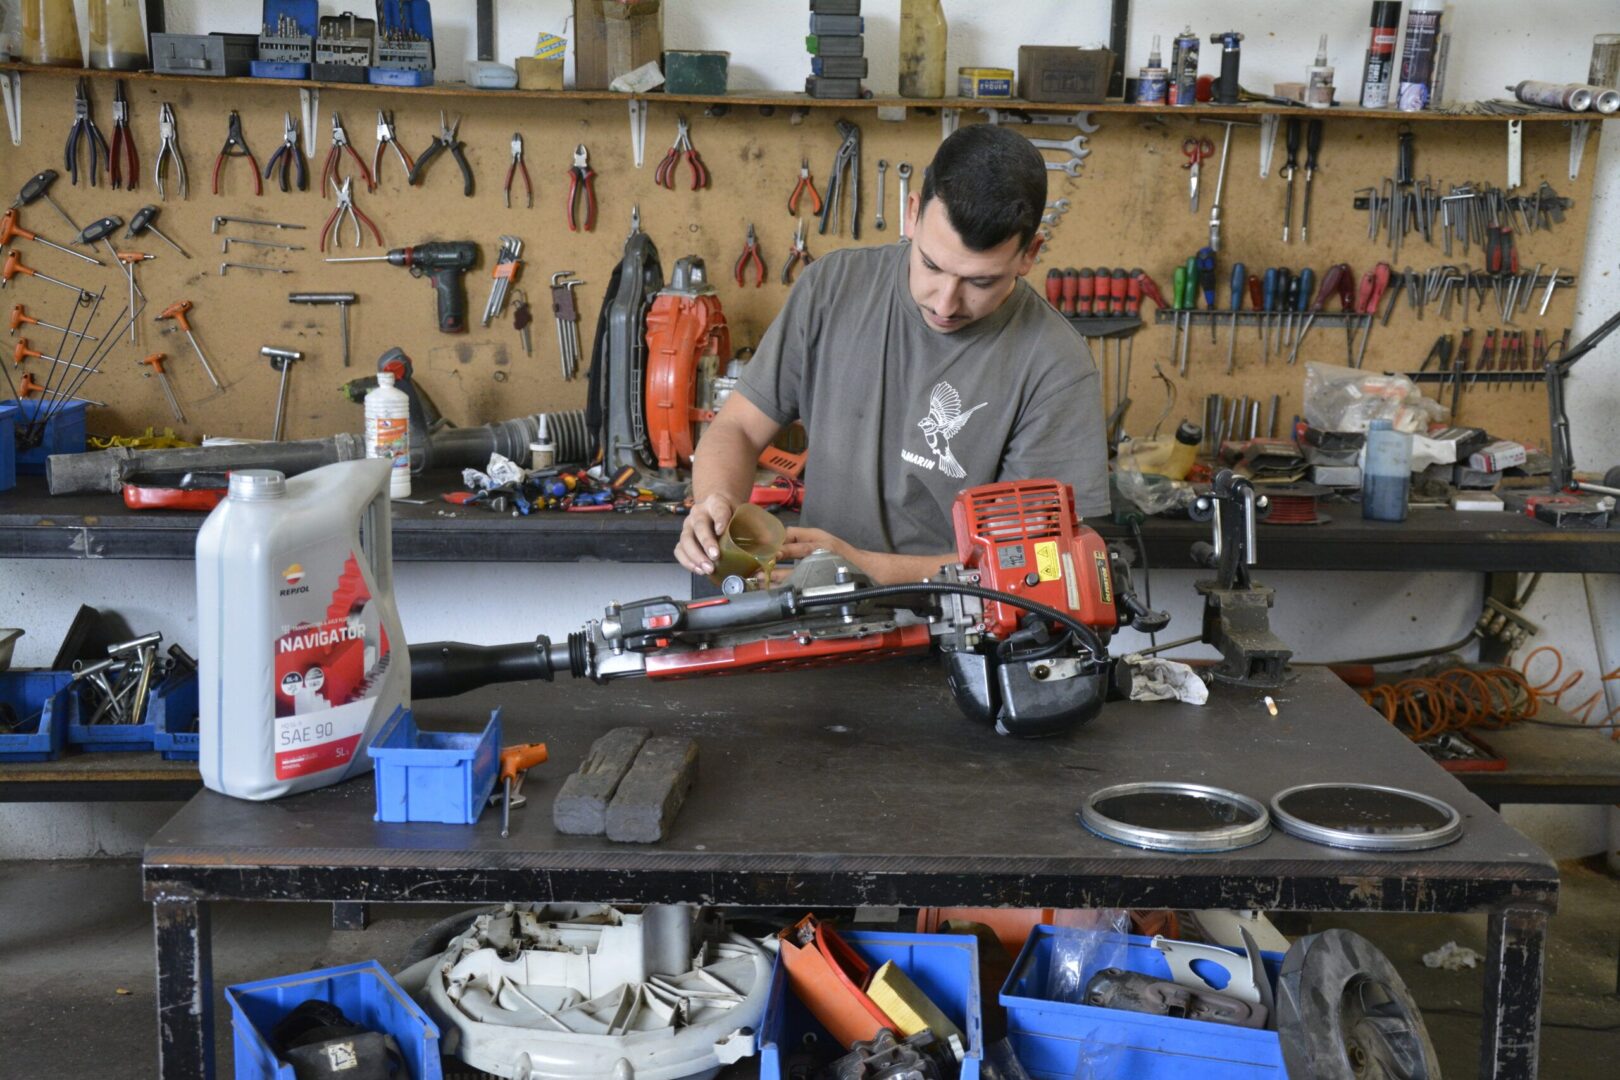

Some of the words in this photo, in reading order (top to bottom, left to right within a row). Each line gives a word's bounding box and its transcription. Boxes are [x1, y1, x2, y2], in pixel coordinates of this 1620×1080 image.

[280, 586, 310, 596] REPSOL
[280, 623, 366, 653] NAVIGATOR
[281, 727, 311, 746] SAE
[315, 722, 333, 739] 90
